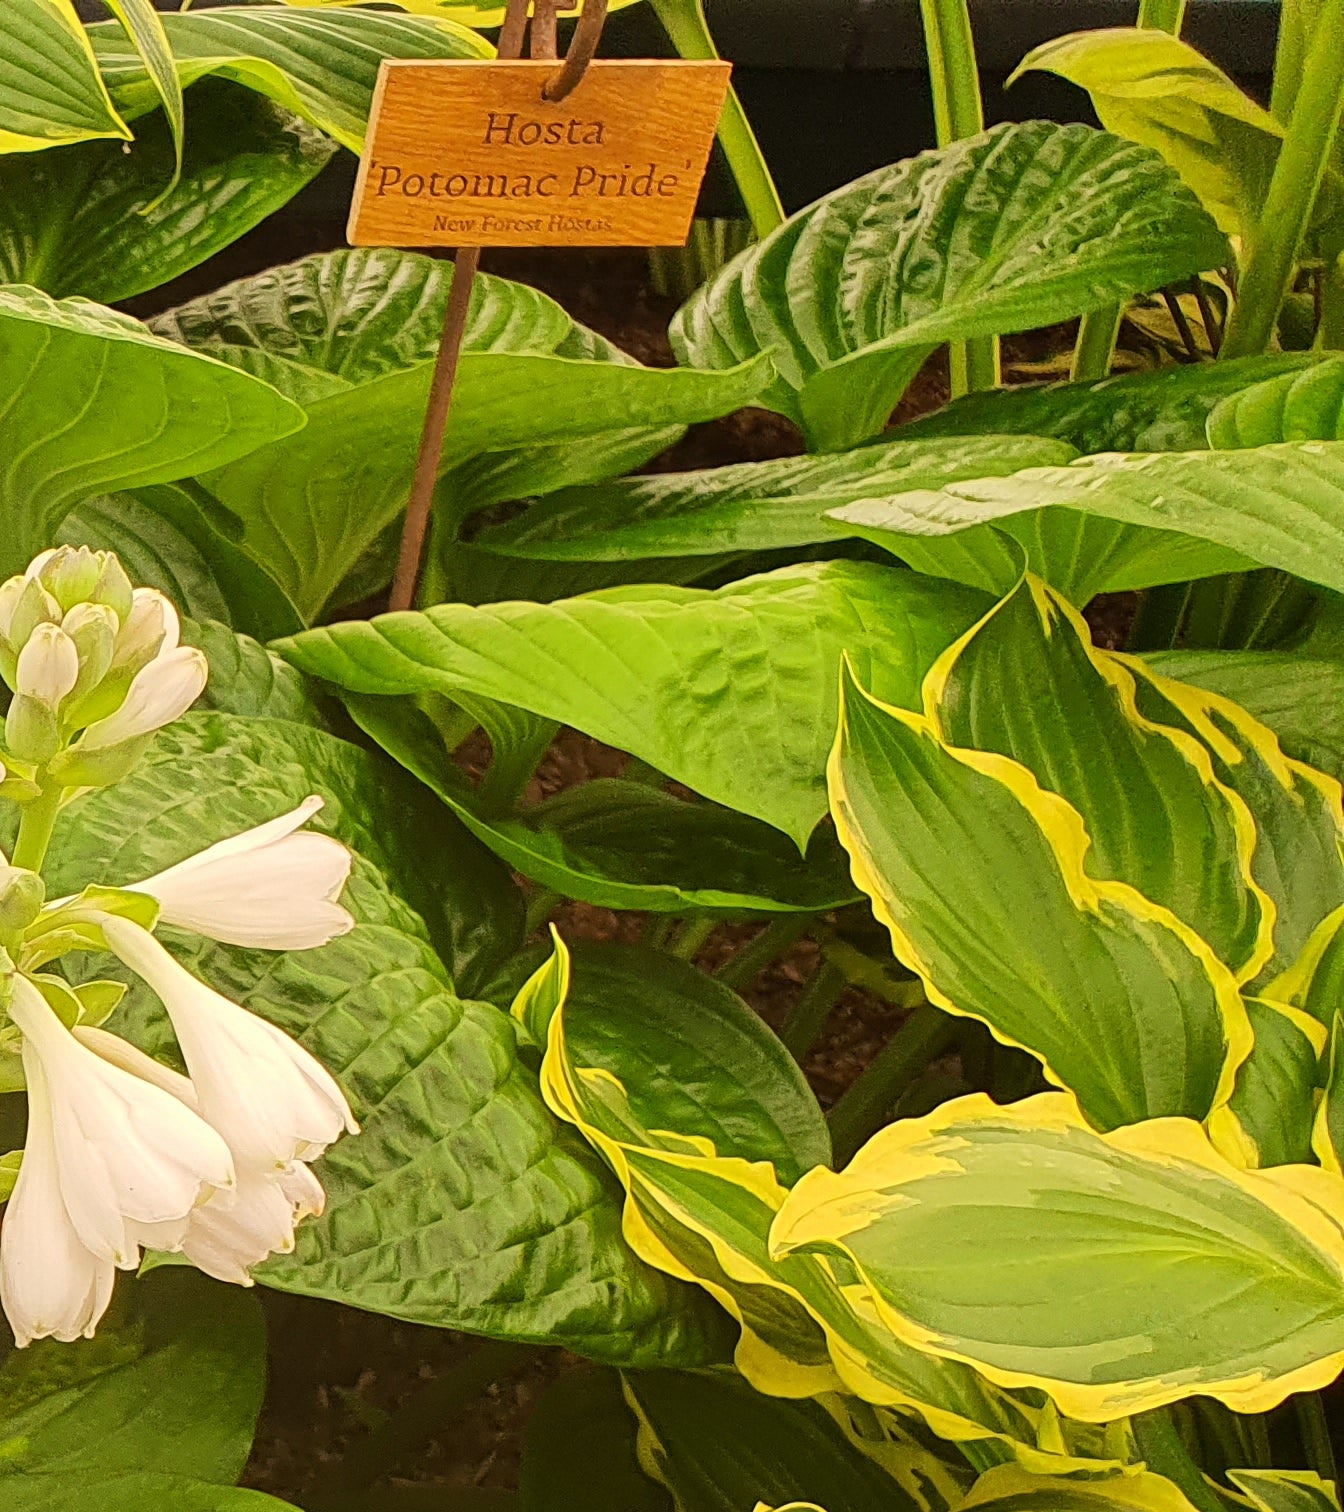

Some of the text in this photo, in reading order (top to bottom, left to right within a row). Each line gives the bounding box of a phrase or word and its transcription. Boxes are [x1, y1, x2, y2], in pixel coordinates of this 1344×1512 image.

[481, 112, 604, 146] Hosta
[370, 159, 692, 197] 'Potomac Pride'
[433, 214, 475, 233] New
[481, 214, 544, 232] Forest
